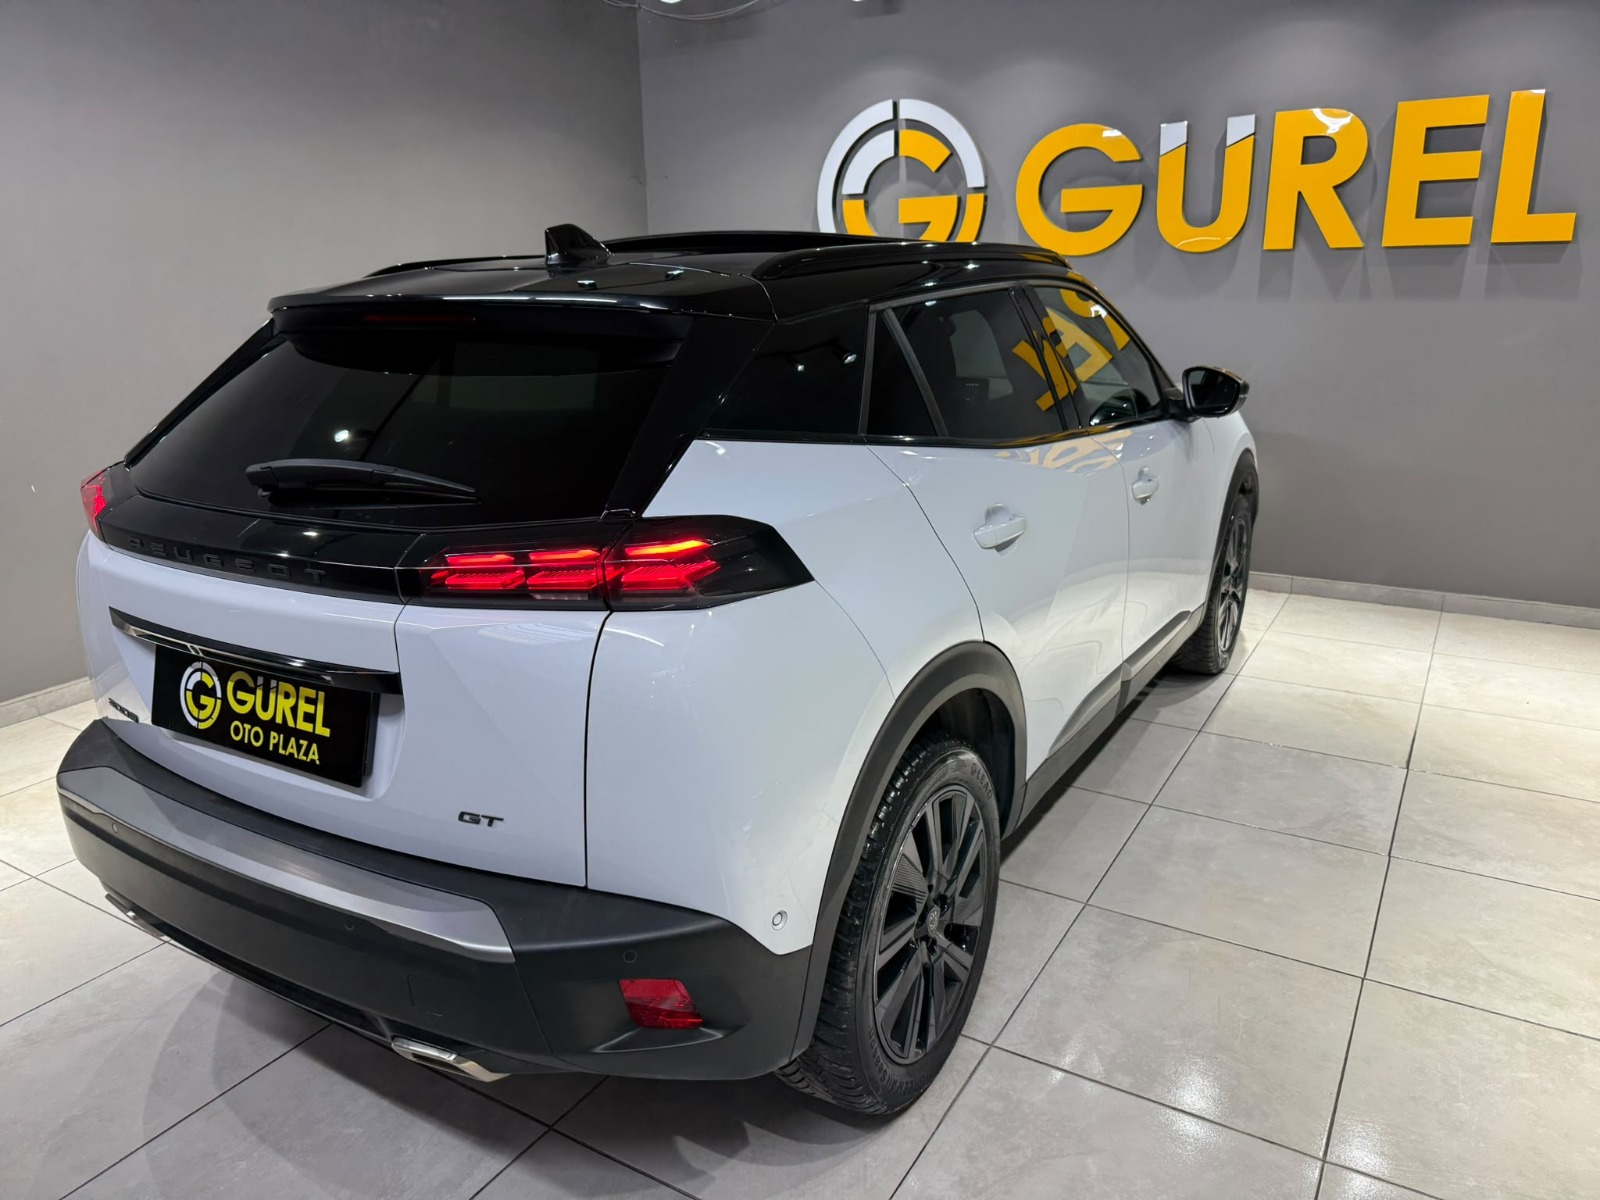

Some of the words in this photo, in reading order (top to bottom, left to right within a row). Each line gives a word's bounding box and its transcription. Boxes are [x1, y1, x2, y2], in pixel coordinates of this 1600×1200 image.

[128, 536, 327, 584] PEUGEOT
[230, 720, 264, 747] OTO
[269, 730, 320, 765] PLAZA
[457, 811, 505, 828] GT
